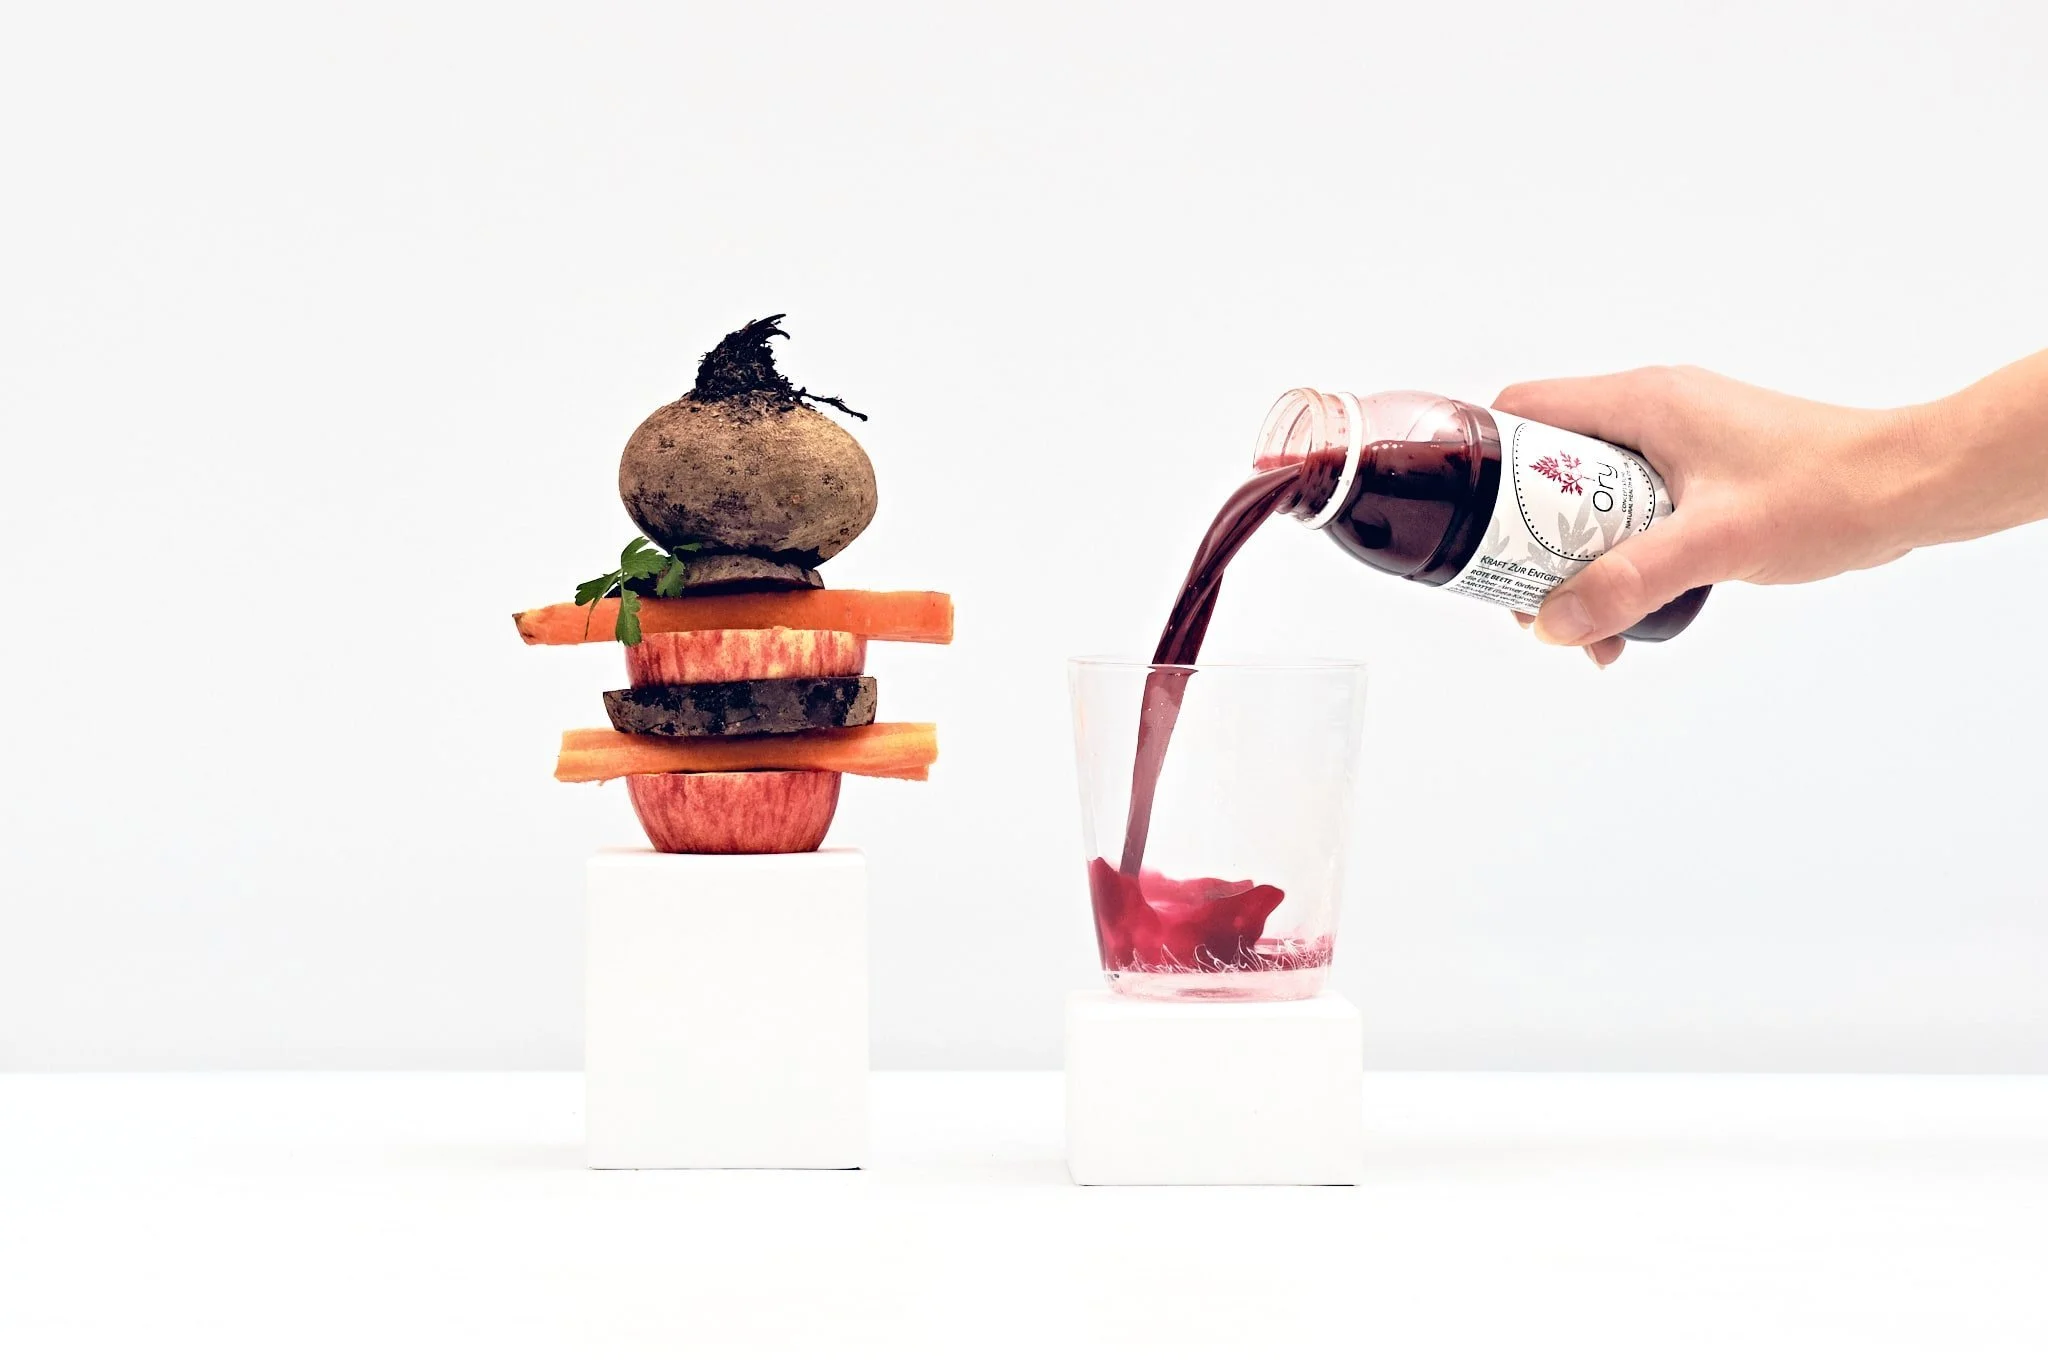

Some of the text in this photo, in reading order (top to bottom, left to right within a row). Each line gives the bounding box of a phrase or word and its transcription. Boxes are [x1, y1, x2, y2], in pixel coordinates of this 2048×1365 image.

[1593, 462, 1618, 512] Ory
[1625, 503, 1633, 529] NATURAL
[1461, 580, 1492, 591] KAROTTE
[1470, 569, 1490, 579] ROTE
[1490, 574, 1513, 585] BEETE
